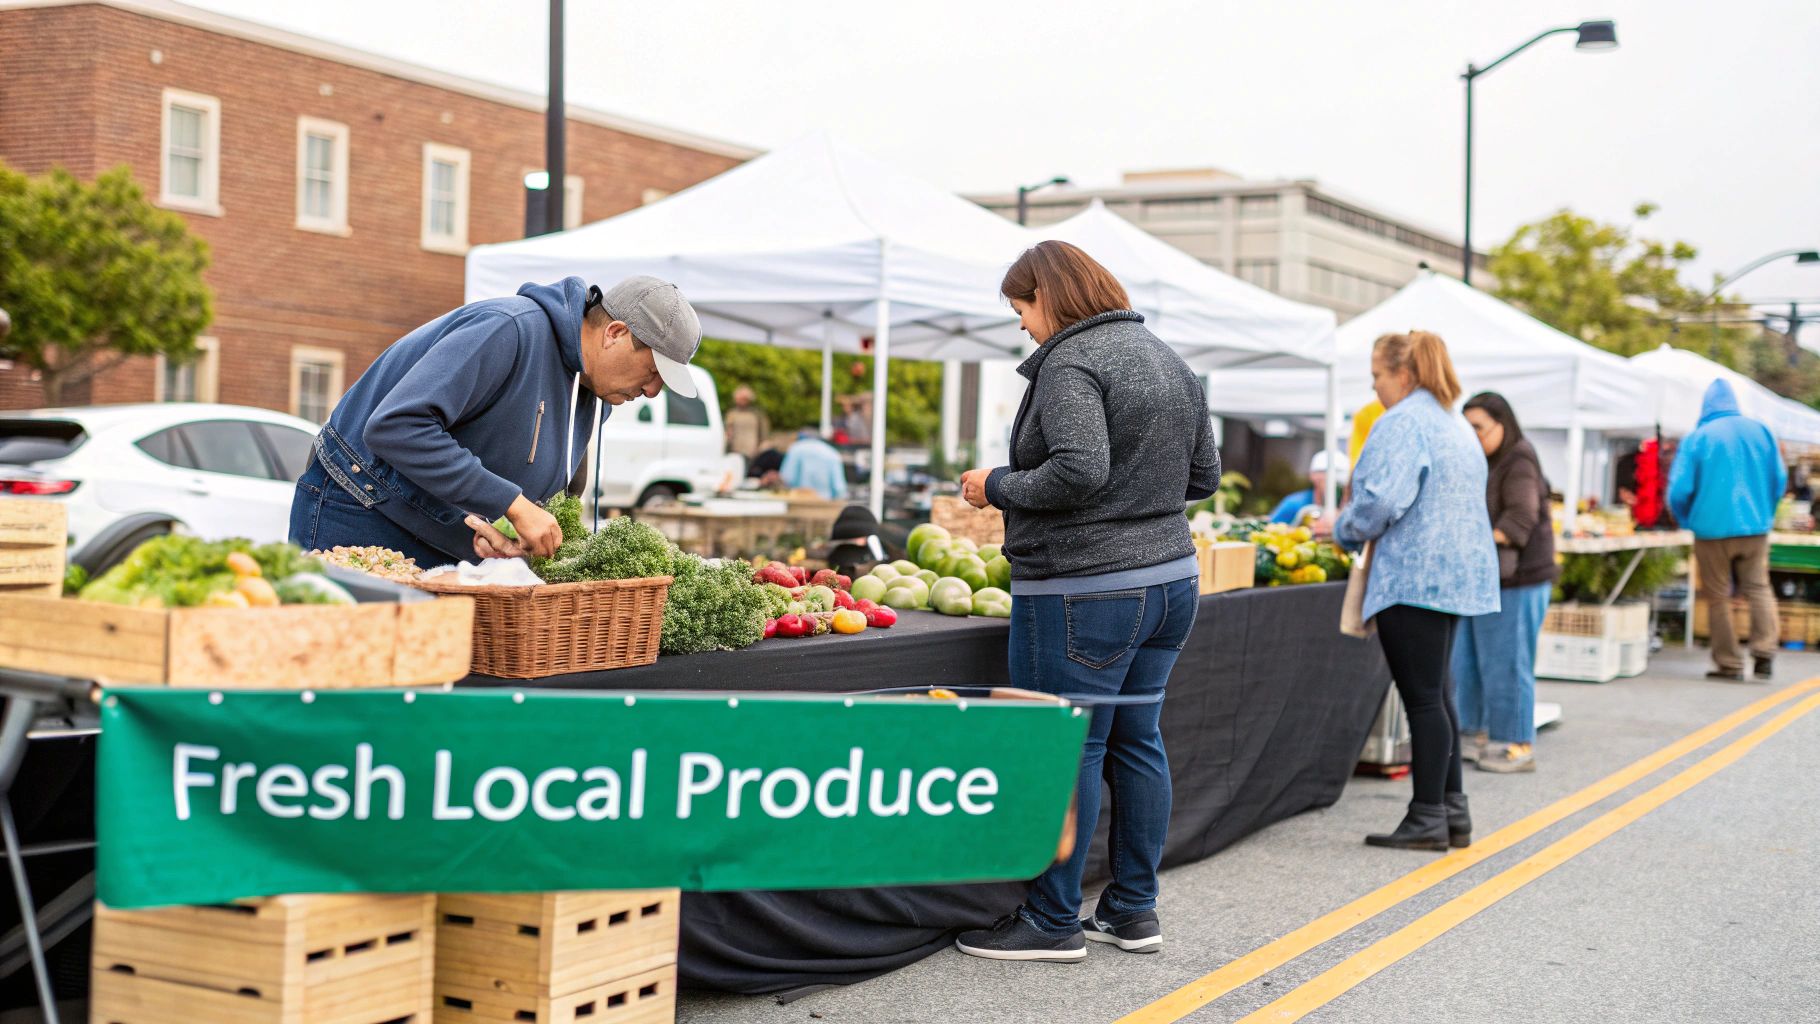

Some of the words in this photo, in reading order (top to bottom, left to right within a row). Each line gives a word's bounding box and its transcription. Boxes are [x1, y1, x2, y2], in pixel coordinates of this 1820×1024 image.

[172, 743, 405, 821] Fresh
[432, 749, 648, 822] Local
[676, 746, 1000, 820] Produce
